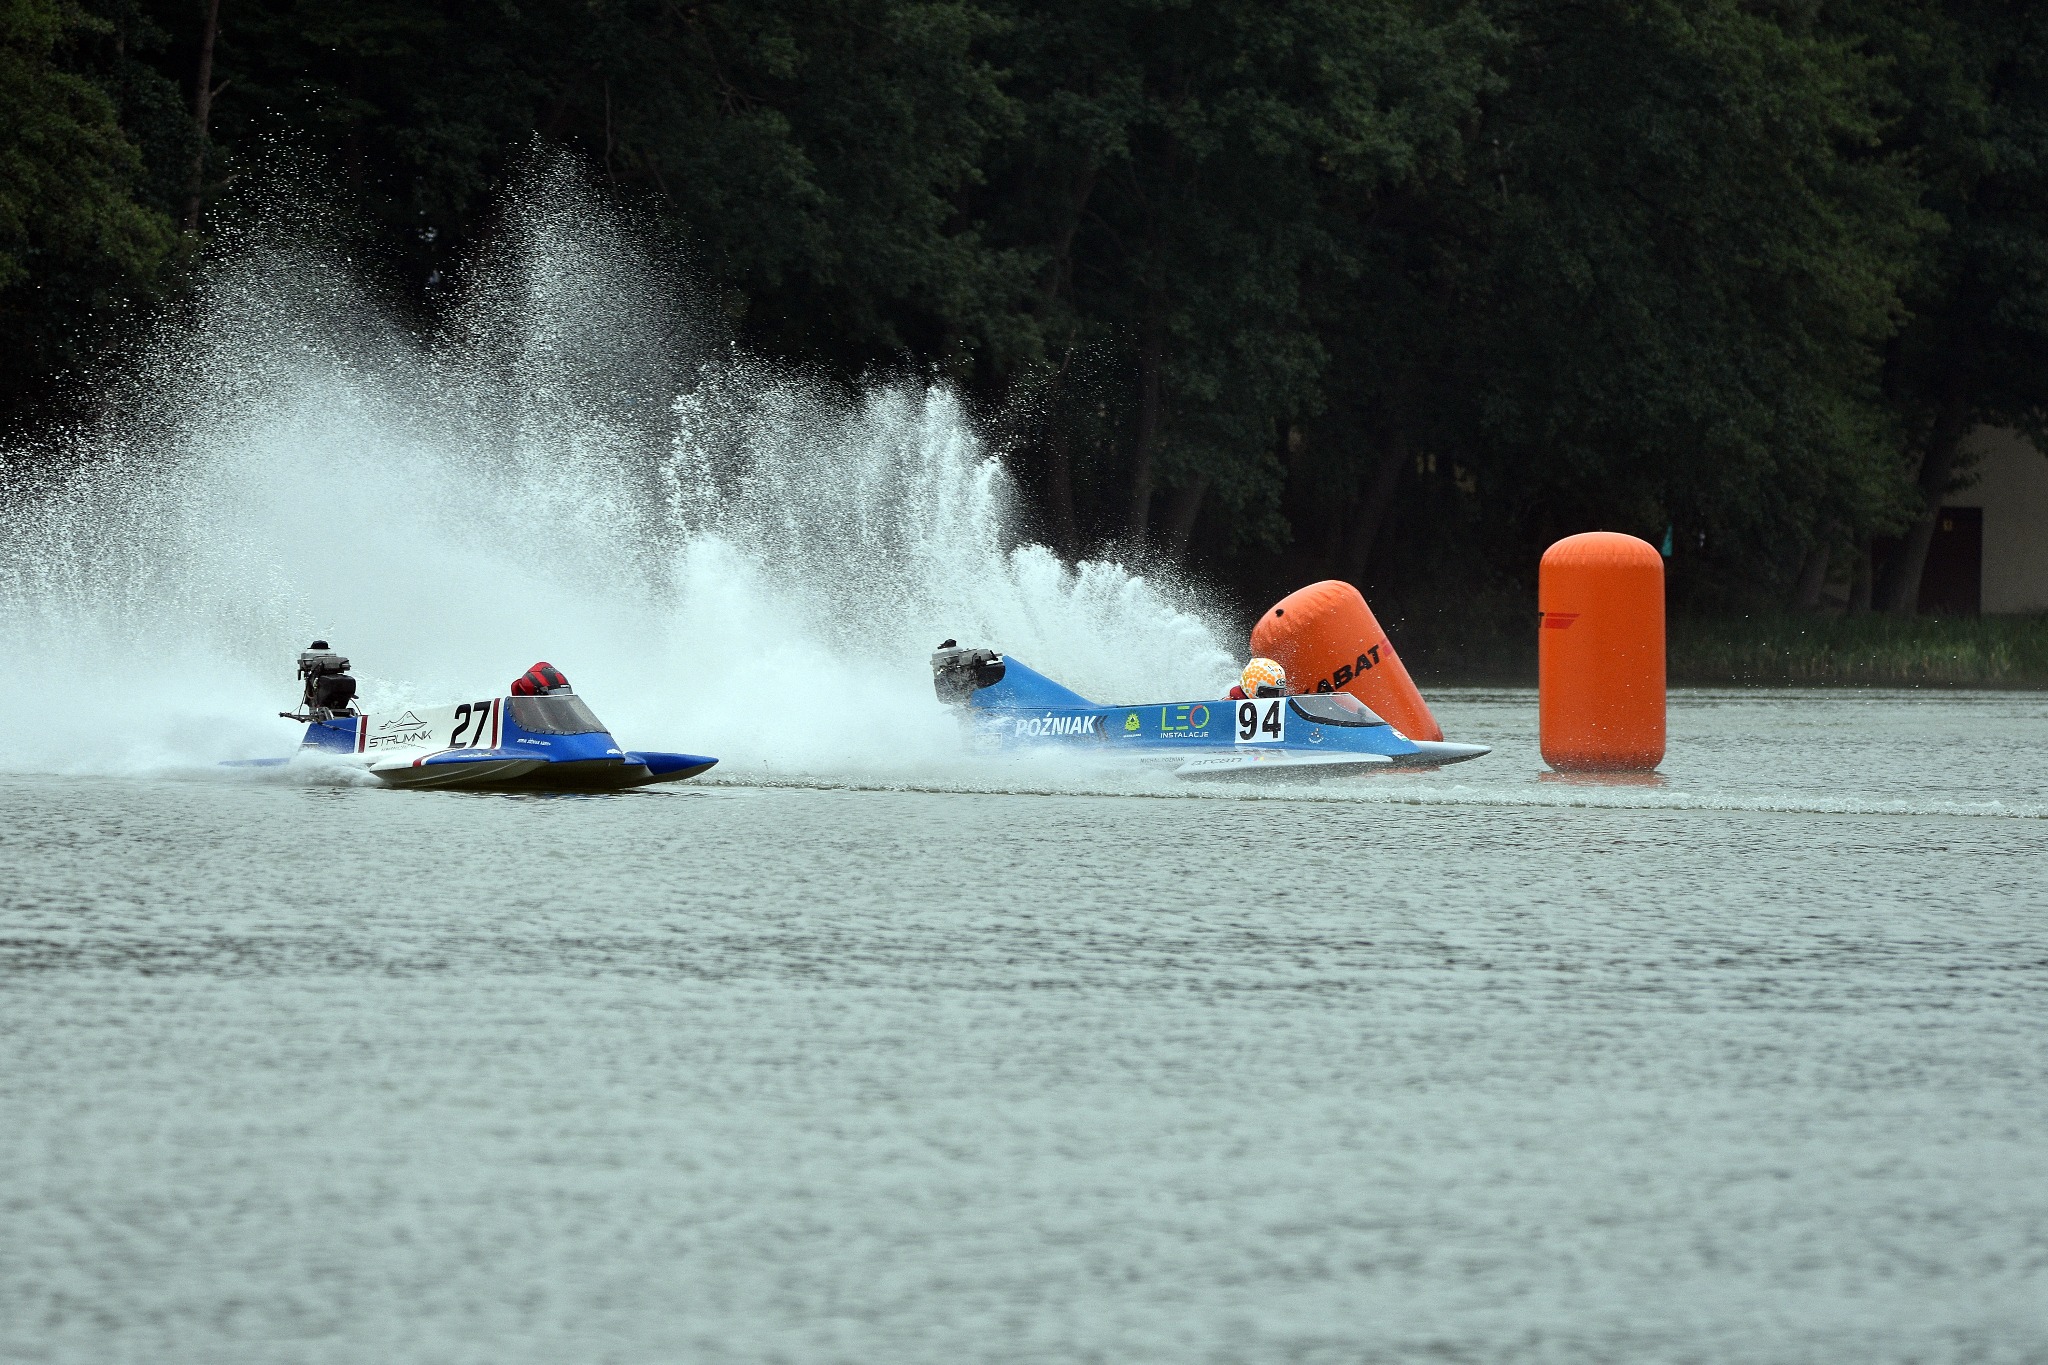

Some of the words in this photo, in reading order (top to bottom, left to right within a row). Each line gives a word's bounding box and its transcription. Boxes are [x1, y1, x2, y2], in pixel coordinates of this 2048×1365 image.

[1302, 644, 1380, 694] ABAT
[449, 701, 491, 748] 27
[1015, 712, 1096, 738] POŹNIAK
[1161, 704, 1210, 731] LEO
[1238, 700, 1281, 740] 94
[1160, 731, 1209, 739] INSTALACJE
